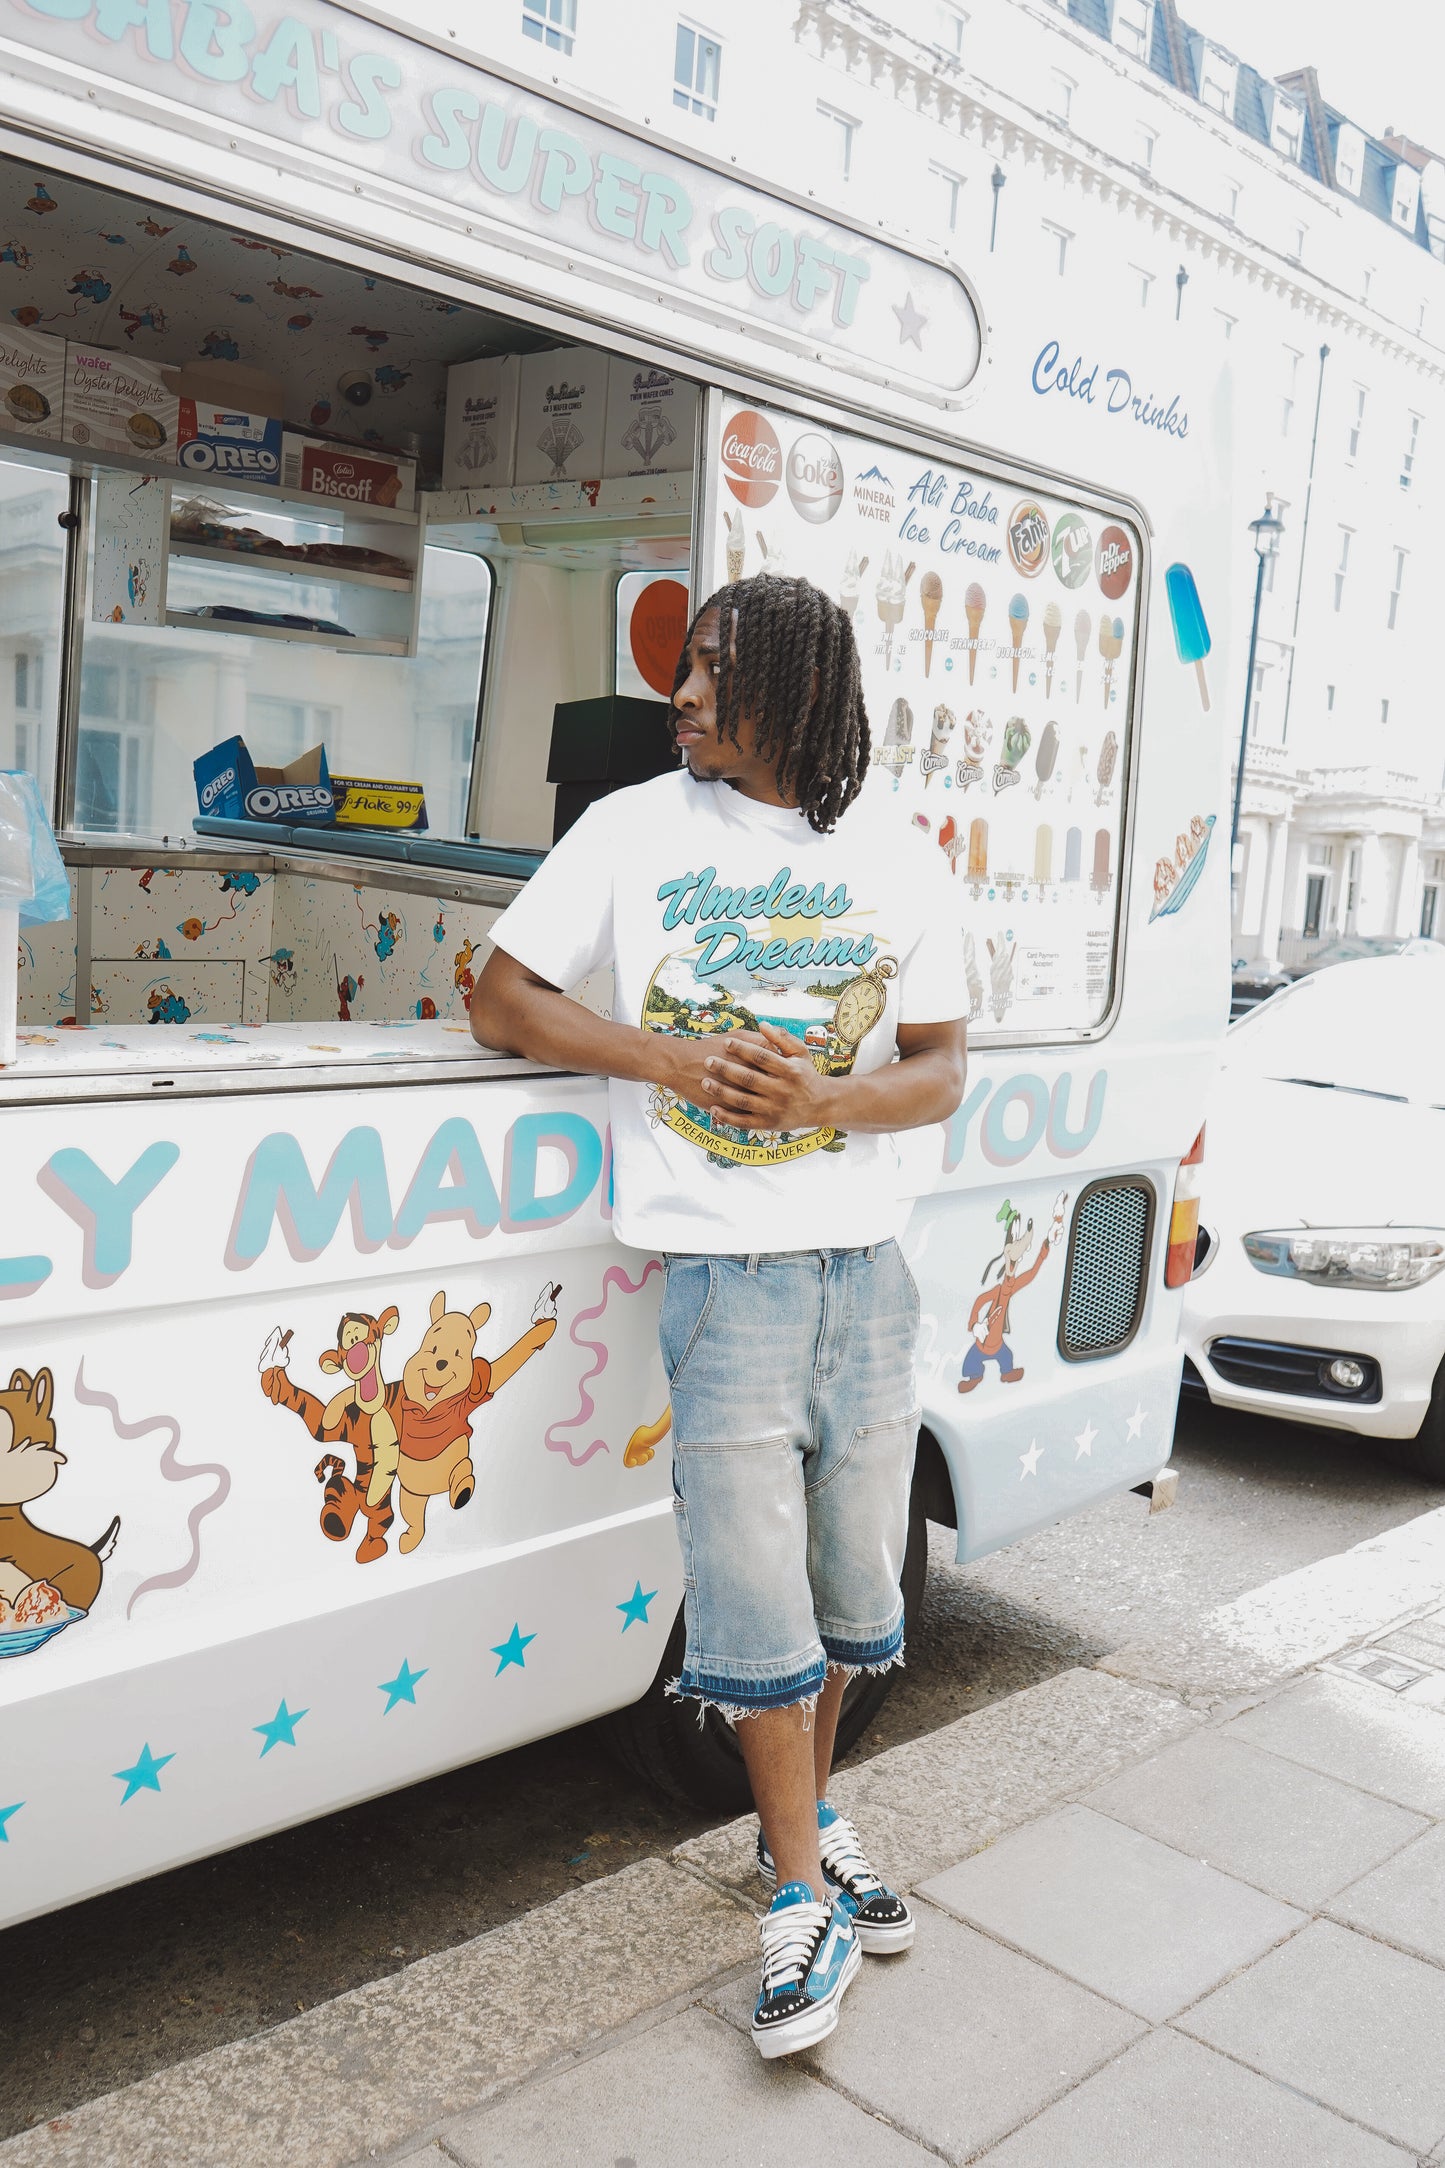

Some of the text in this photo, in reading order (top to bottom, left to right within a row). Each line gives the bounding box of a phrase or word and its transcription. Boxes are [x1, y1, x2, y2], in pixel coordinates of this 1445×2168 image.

[413, 87, 694, 270] SUPER
[704, 206, 871, 328] SOFT
[76, 355, 112, 371] wafer
[73, 367, 165, 407] Oyster Delights
[630, 388, 674, 401] TWIN WAFER CONES
[1032, 341, 1190, 440] Cold Drinks
[179, 441, 279, 474] OREO
[336, 465, 352, 475] Lotus
[791, 453, 838, 489] Coke
[311, 467, 373, 502] Biscoff
[853, 485, 896, 508] MINERAL
[907, 469, 999, 526] Ali Baba
[857, 503, 891, 523] WATER
[898, 507, 1002, 564] Ice Cream
[1009, 517, 1050, 563] Fanta
[1107, 542, 1121, 558] Dr
[1099, 549, 1131, 576] Pepper
[908, 628, 950, 643] CHOCOLATE
[873, 744, 916, 766] FEAST
[201, 768, 235, 808] OREO
[245, 787, 334, 817] OREO
[352, 793, 395, 814] flake
[396, 800, 412, 814] 99
[353, 781, 371, 789] CREAM
[384, 784, 409, 792] CULINARY
[409, 785, 419, 793] USE
[694, 921, 879, 978] Dreams
[674, 1116, 835, 1162] DREAMS THAT NEVER END
[223, 1110, 616, 1273] MAD
[940, 1069, 1108, 1175] YOU
